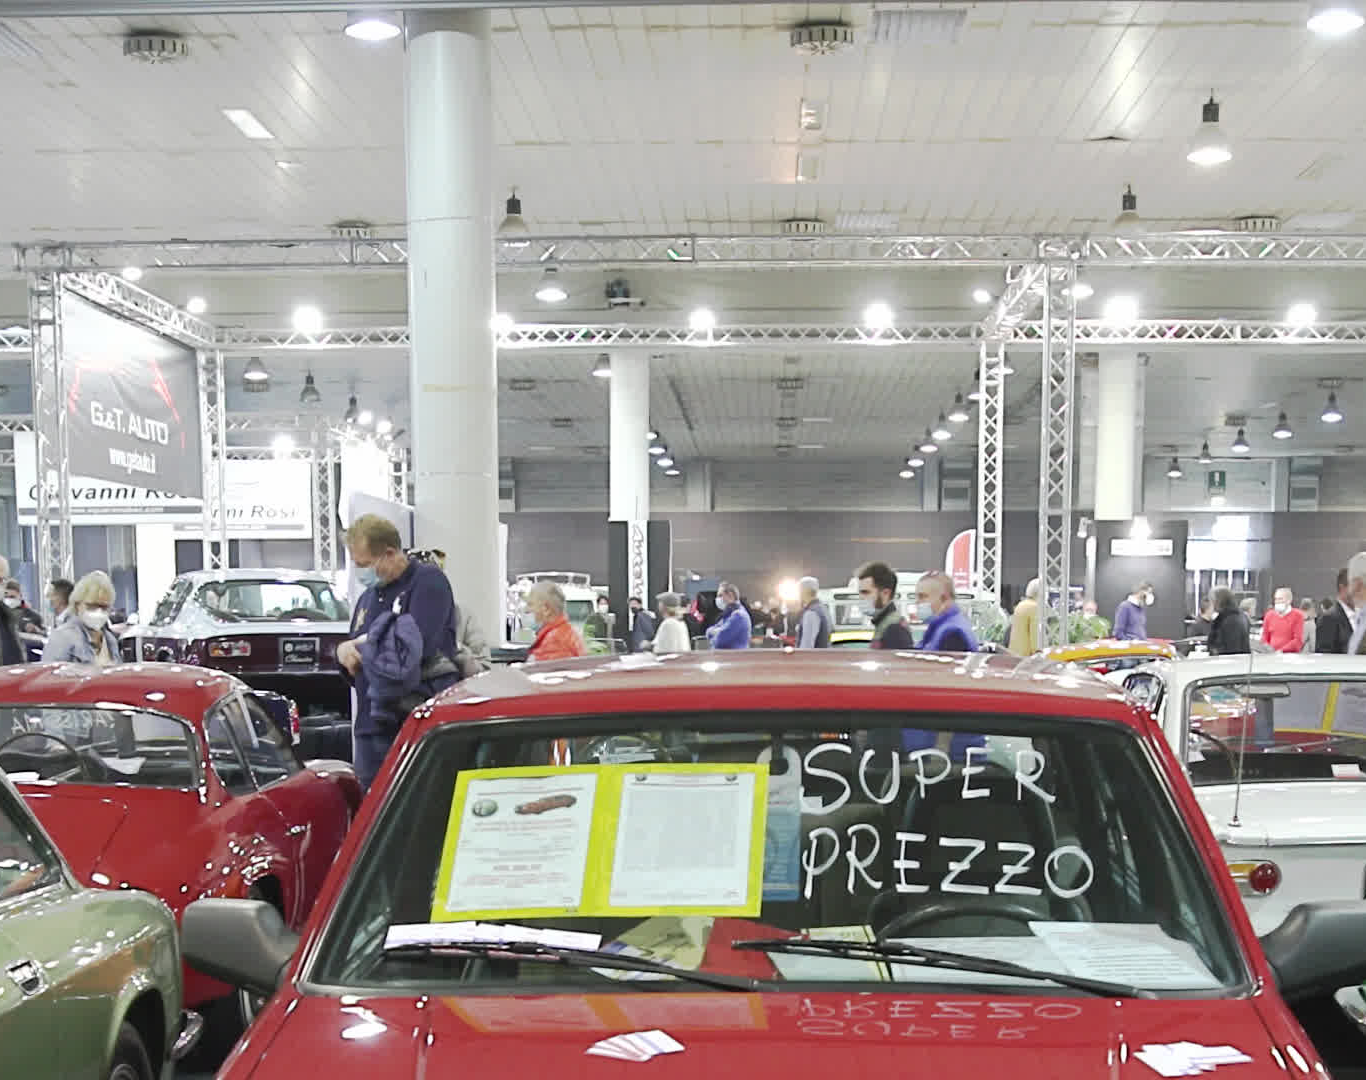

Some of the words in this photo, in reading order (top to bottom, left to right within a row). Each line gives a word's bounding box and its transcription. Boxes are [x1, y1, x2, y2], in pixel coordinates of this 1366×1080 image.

[128, 412, 169, 445] AUTO
[800, 742, 1056, 815] SUPER
[802, 823, 1094, 899] PREZZO
